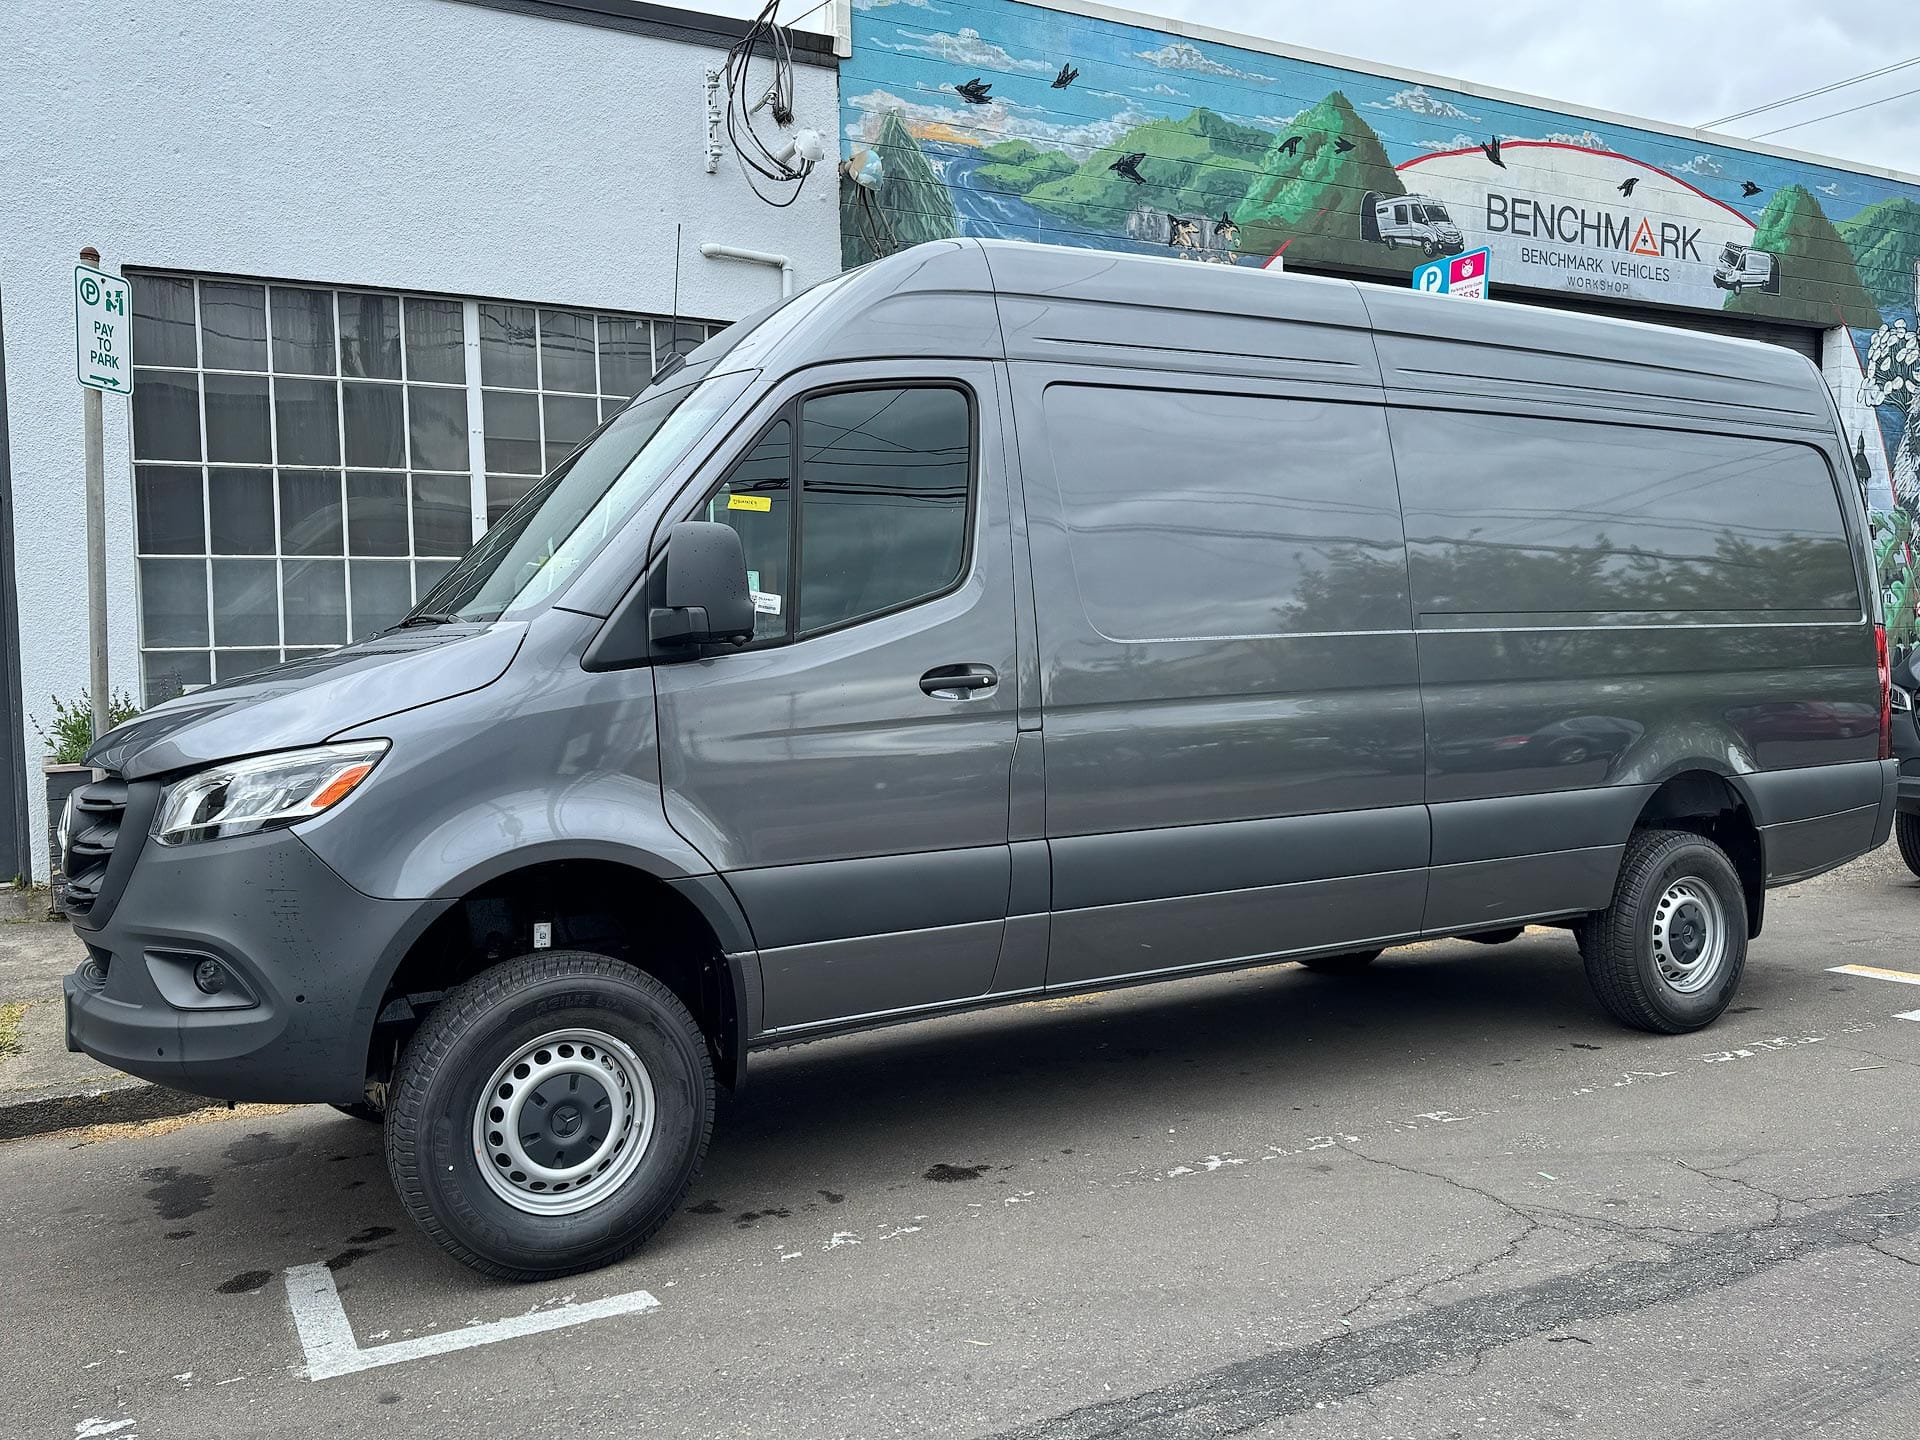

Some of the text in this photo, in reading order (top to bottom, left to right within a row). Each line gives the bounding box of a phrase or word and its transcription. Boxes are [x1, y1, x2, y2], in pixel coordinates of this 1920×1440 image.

[1486, 193, 1702, 262] BENCHMARK
[1521, 247, 1670, 282] BENCHMARK VEHICLES
[1426, 271, 1438, 291] P
[1566, 275, 1629, 293] WORKSHOP
[85, 283, 96, 300] P
[94, 320, 114, 338] PAY
[97, 336, 112, 352] TO
[90, 350, 120, 370] PARK
